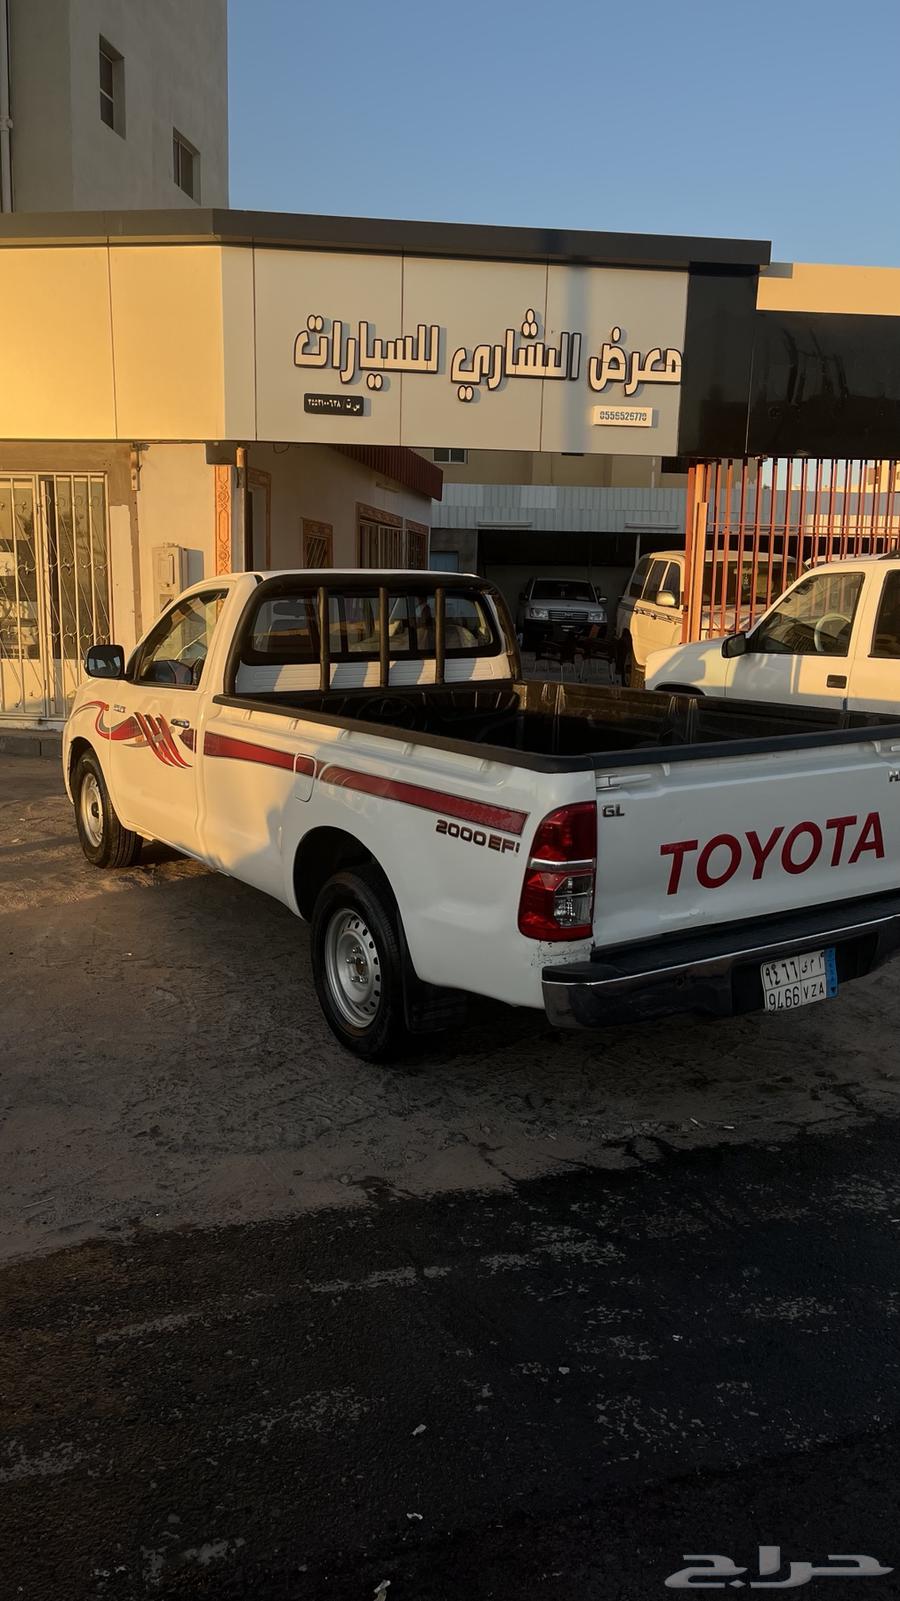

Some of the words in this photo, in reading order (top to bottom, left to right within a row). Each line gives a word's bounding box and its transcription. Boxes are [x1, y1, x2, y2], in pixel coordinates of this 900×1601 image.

[293, 314, 441, 390] للسيارات
[451, 308, 582, 403] الشاري
[589, 326, 683, 396] معرض
[602, 804, 625, 817] GL
[660, 812, 885, 895] TOYOTA
[769, 986, 800, 1013] 9466
